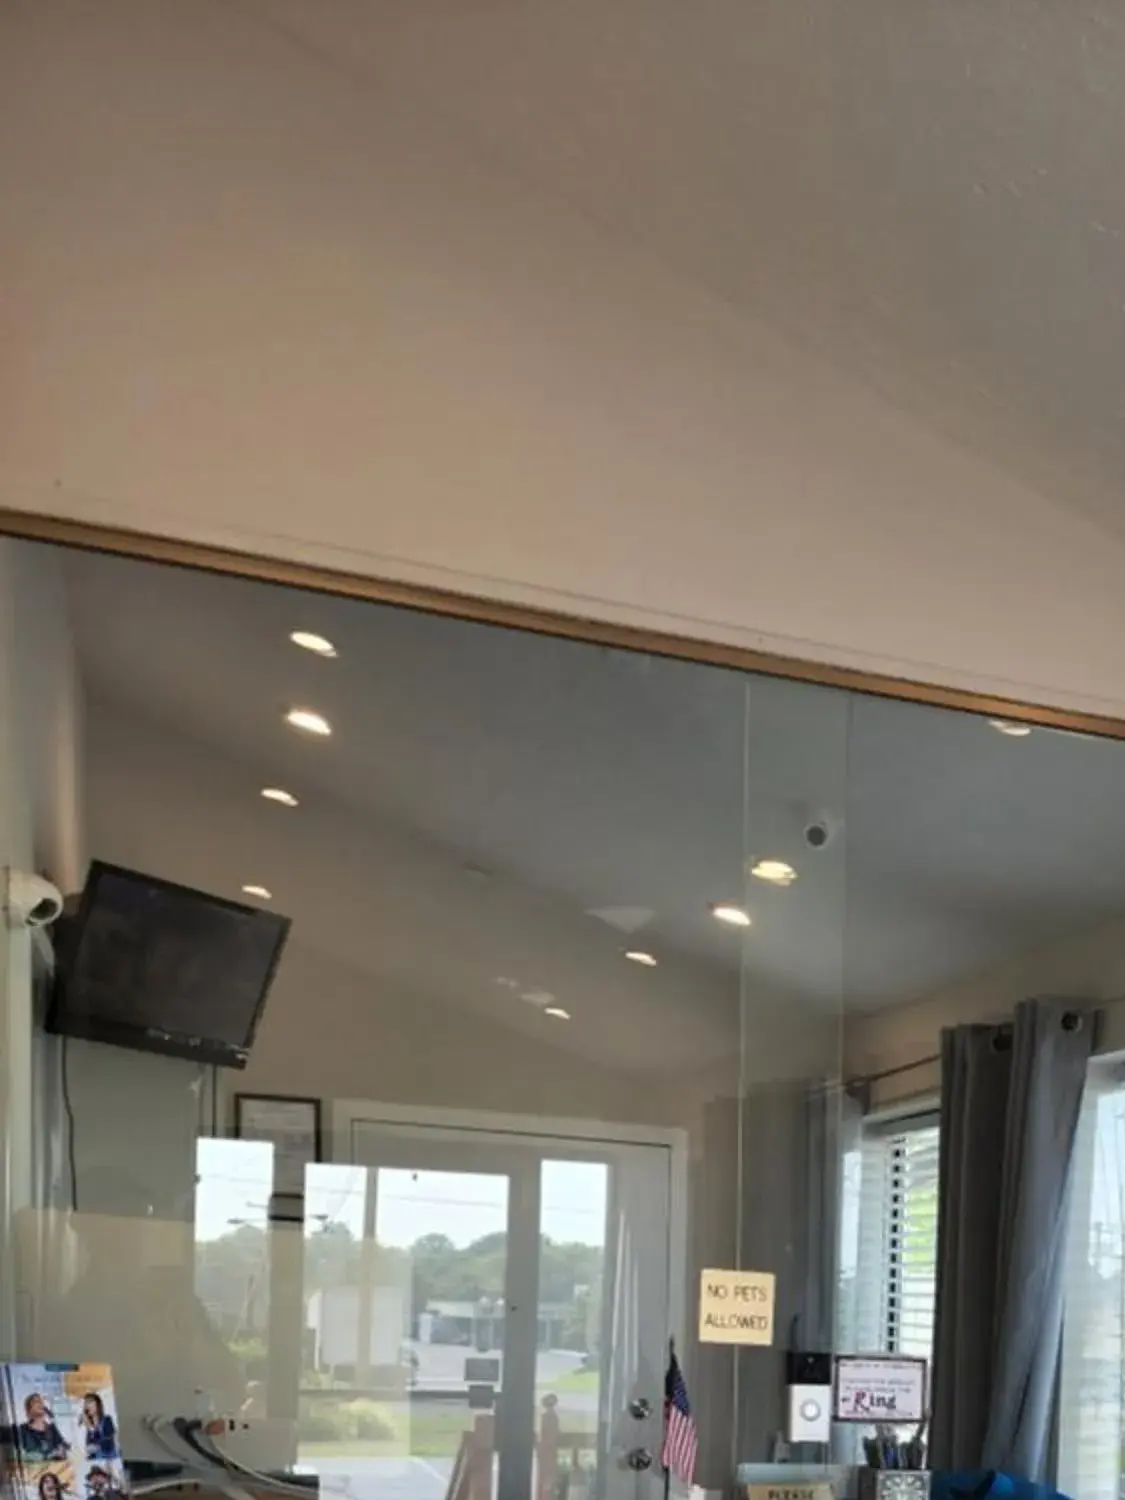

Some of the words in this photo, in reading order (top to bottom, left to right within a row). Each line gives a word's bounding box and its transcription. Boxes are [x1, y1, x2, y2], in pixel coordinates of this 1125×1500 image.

[707, 1284, 728, 1300] NO
[734, 1286, 767, 1302] PETS
[705, 1312, 768, 1330] ALLOWED
